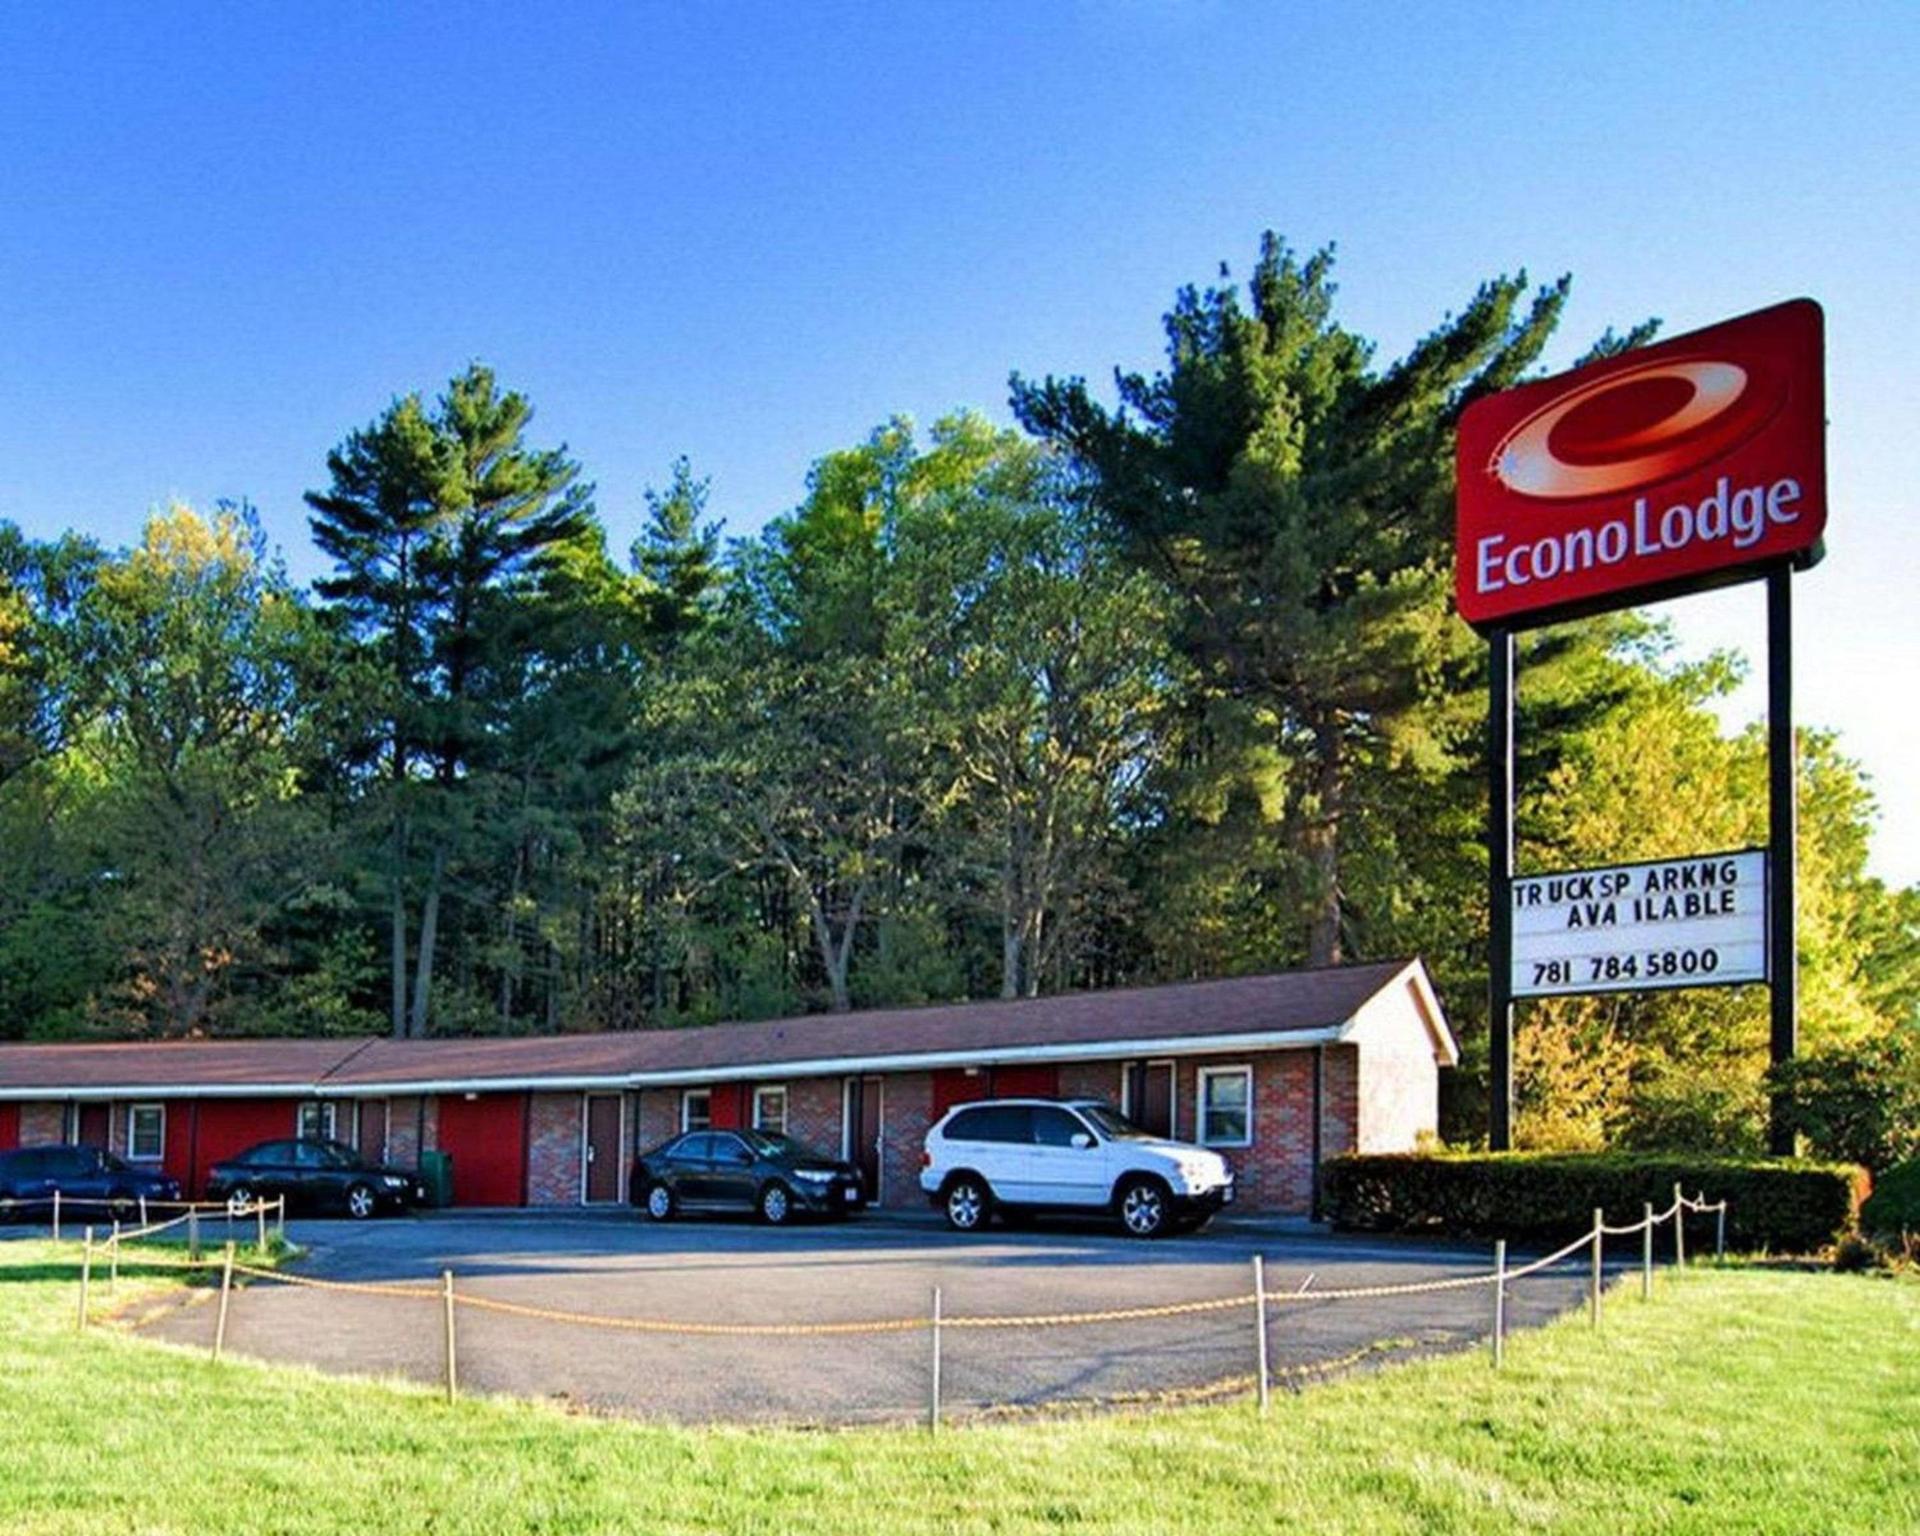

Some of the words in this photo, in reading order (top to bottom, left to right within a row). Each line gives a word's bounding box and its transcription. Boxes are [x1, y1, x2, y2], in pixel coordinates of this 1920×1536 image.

[1533, 960, 1571, 986] 781
[1591, 955, 1638, 980] 784
[1646, 948, 1719, 976] 5800
